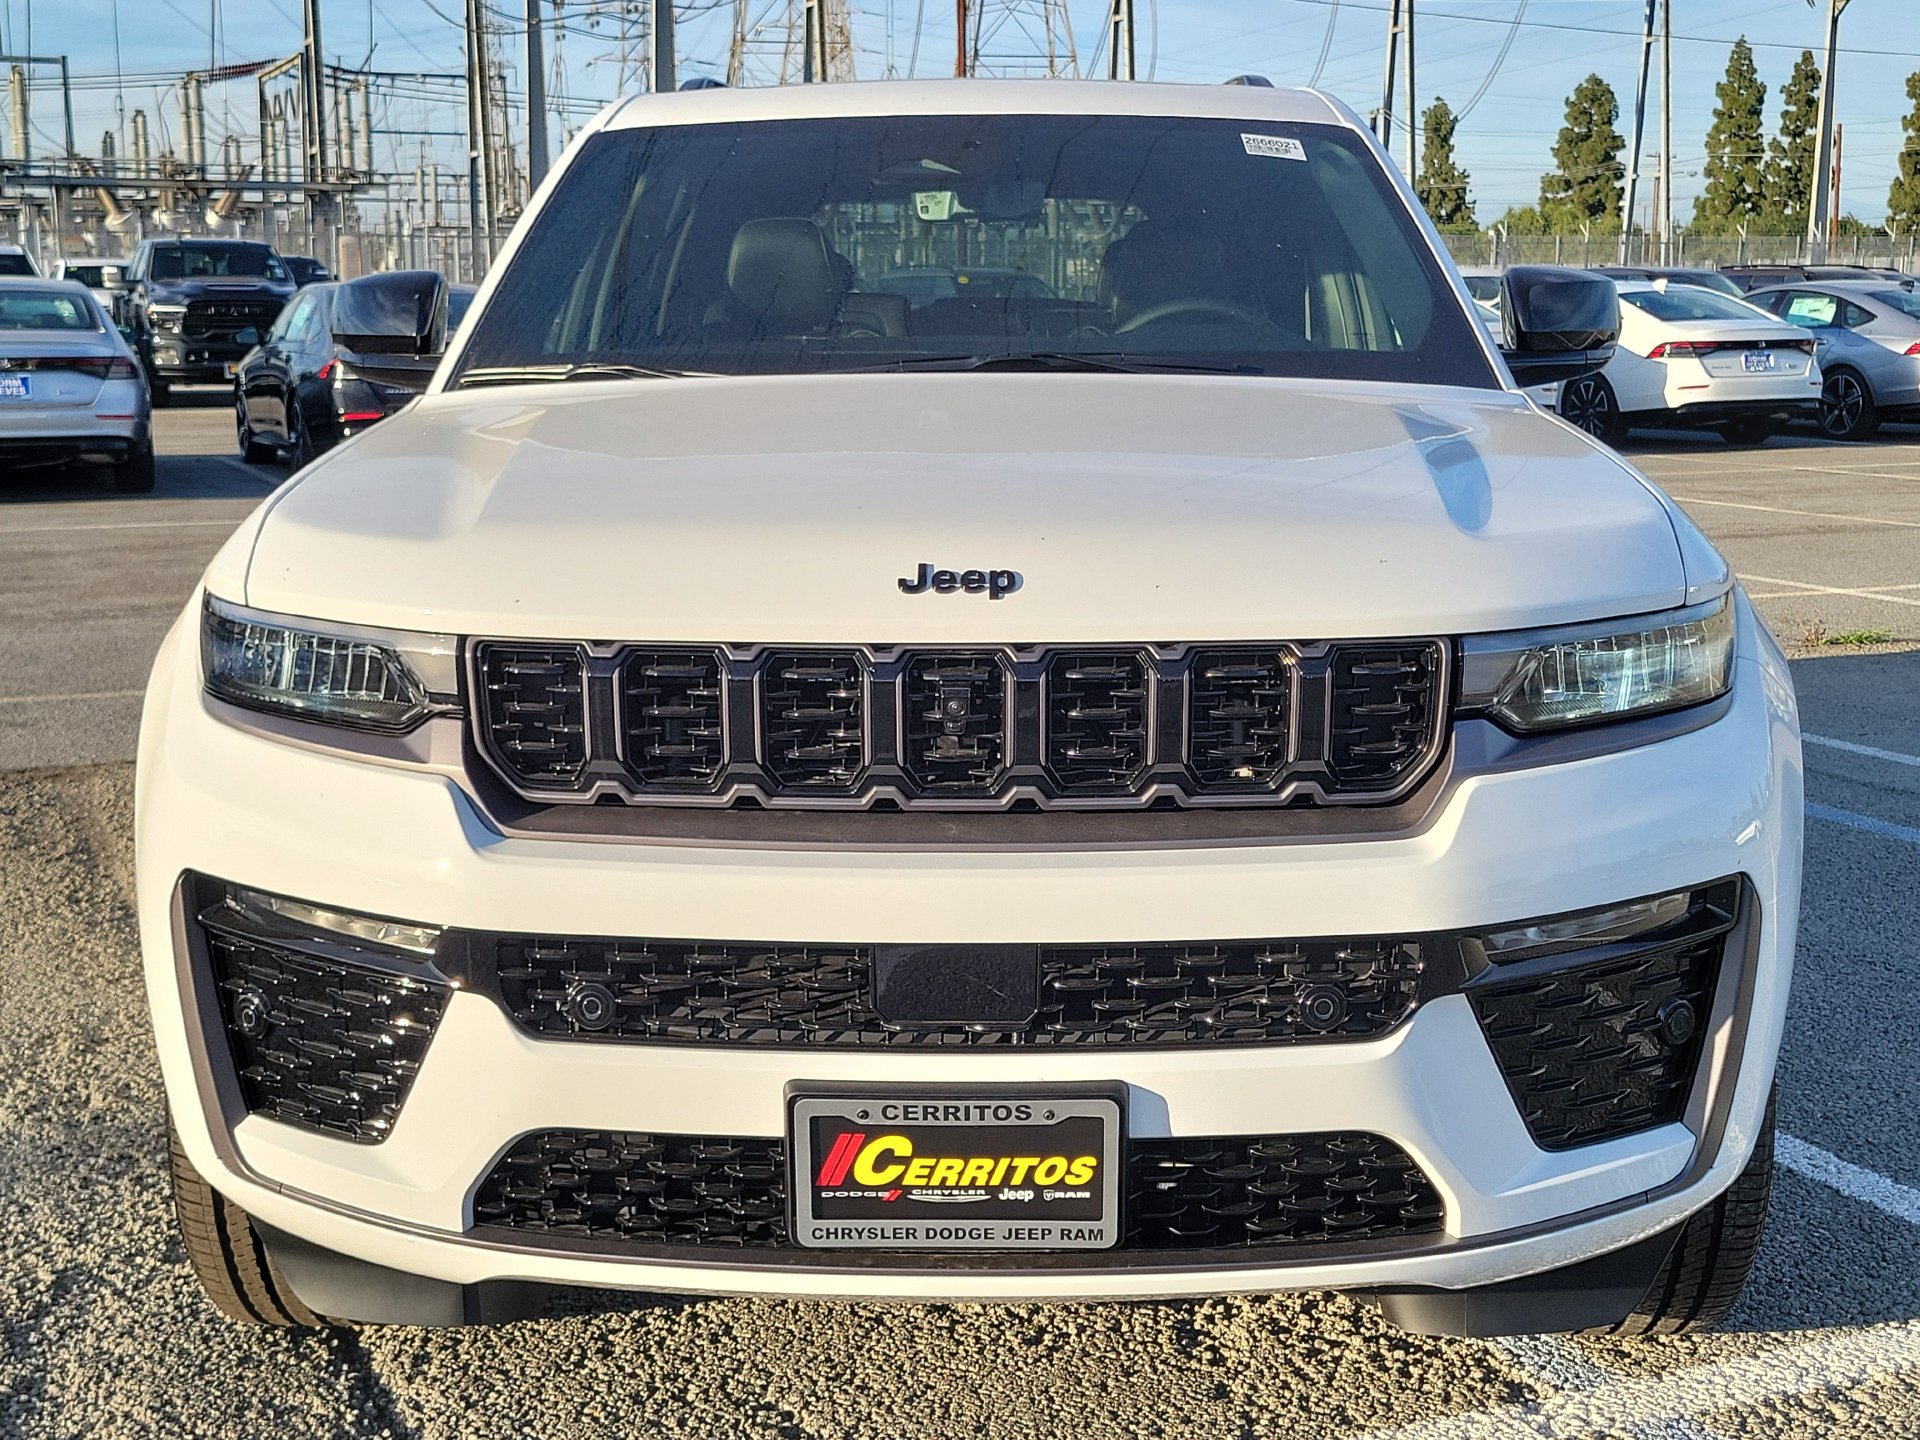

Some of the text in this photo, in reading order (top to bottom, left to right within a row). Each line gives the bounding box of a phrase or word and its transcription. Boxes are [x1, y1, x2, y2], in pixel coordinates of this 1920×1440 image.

[1244, 136, 1299, 150] 2666021
[898, 563, 1023, 600] Jeep
[881, 1104, 1032, 1121] CERRITOS
[853, 1135, 1098, 1187] CERRITOS
[999, 1188, 1034, 1202] Jeep
[1054, 1191, 1091, 1199] RAM
[811, 1227, 1104, 1241] CHRYSLER DODGE JEEP RAM
